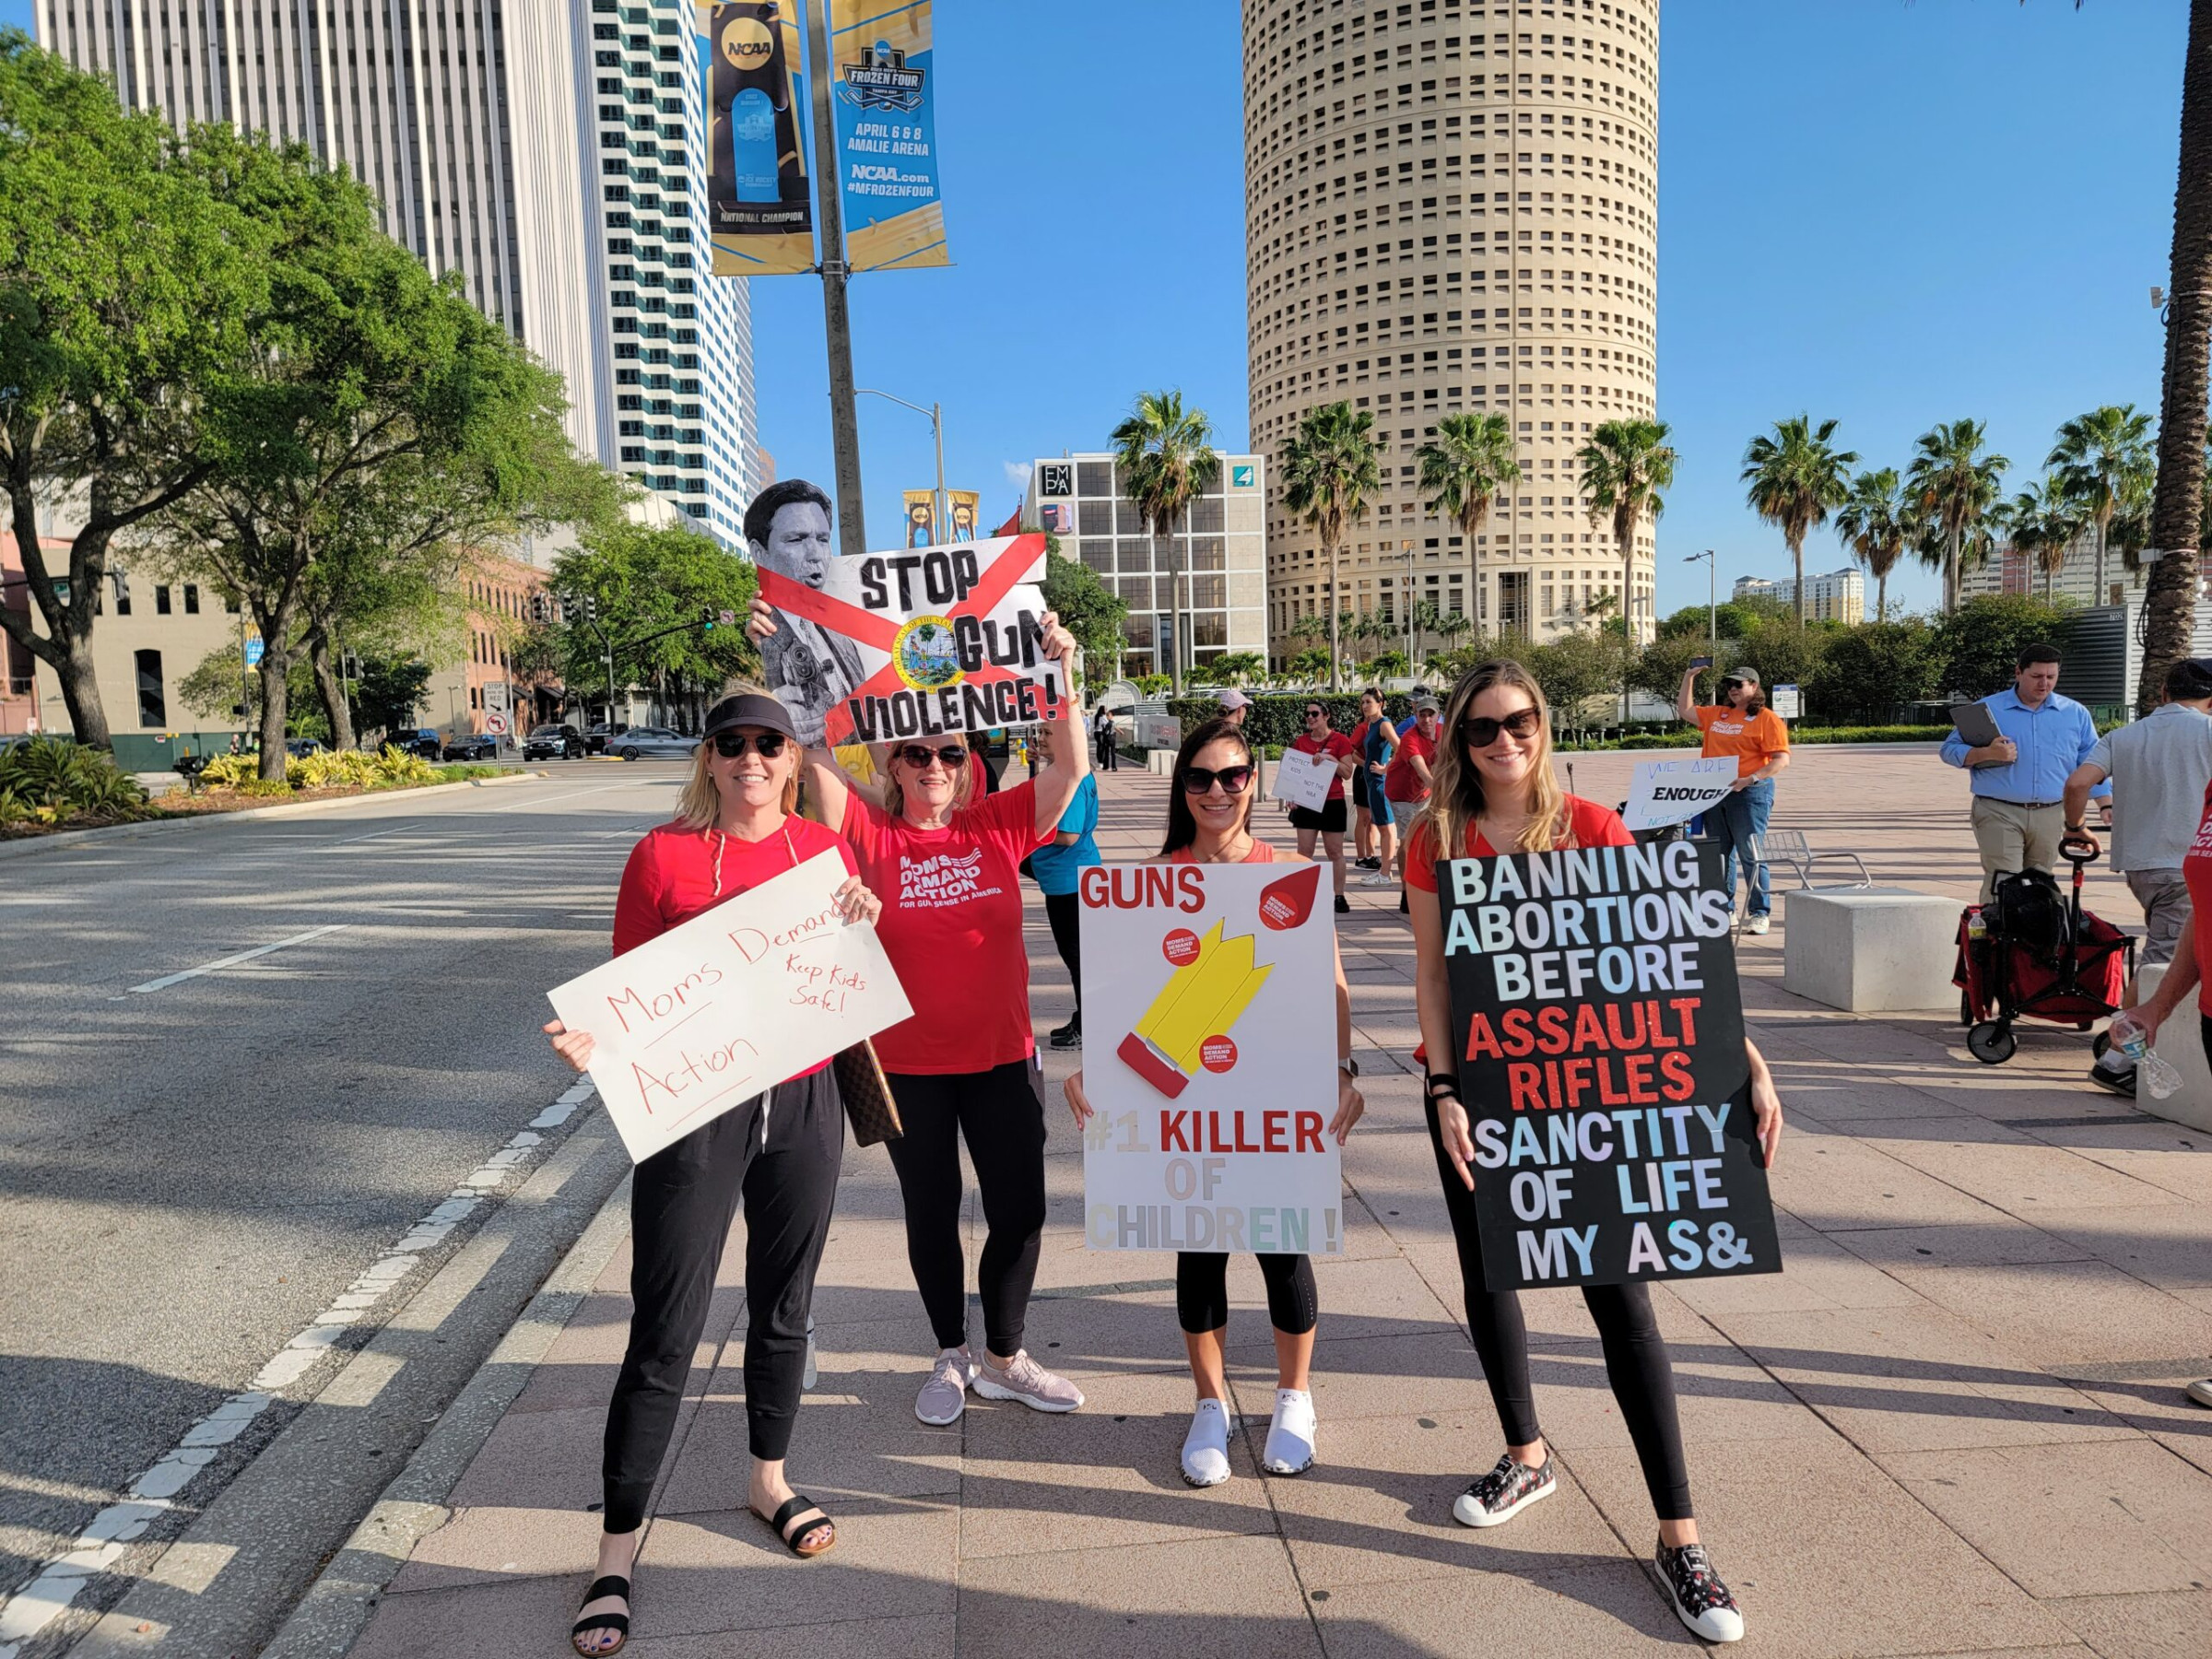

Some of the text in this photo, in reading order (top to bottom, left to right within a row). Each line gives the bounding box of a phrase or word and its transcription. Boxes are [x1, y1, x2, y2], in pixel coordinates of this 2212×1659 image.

[728, 41, 771, 56] NCAA
[851, 70, 919, 87] FROZEN FOUR
[848, 138, 929, 157] AMALIE ARENA
[855, 123, 922, 140] APRIL 6 & 8
[847, 182, 934, 197] #MFROZENFOUR
[852, 164, 929, 183] NCAA.com
[721, 211, 804, 223] NATIONAL CHAMPION
[860, 550, 979, 612] STOP
[849, 673, 1058, 741] VIOLENCE!
[1648, 758, 1731, 780] WE ARE
[1652, 787, 1729, 801] ENOUGH
[1648, 815, 1674, 826] NOT
[900, 878, 978, 900] ACTION
[1080, 865, 1206, 914] GUNS
[1449, 840, 1701, 905] BANNING
[900, 900, 915, 909] FOR
[934, 898, 959, 908] SENSE
[960, 894, 970, 902] IN
[971, 887, 1003, 900] AMERICA
[1444, 888, 1732, 957] ABORTIONS
[606, 892, 846, 1032] Moms Demand
[830, 964, 867, 991] Kids
[1493, 942, 1704, 1002] BEFORE
[789, 986, 846, 1018] Safe!
[1465, 997, 1701, 1062] ASSAULT
[630, 1038, 759, 1115] Action
[1506, 1051, 1696, 1112] RIFLES
[1084, 1110, 1325, 1154] #1 KILLER
[1475, 1102, 1732, 1169] SANCTITY
[1164, 1158, 1226, 1202] OF
[1510, 1158, 1729, 1222] OF LIFE
[1088, 1204, 1310, 1252] CHILDREN
[1515, 1219, 1753, 1281] MY AS&
